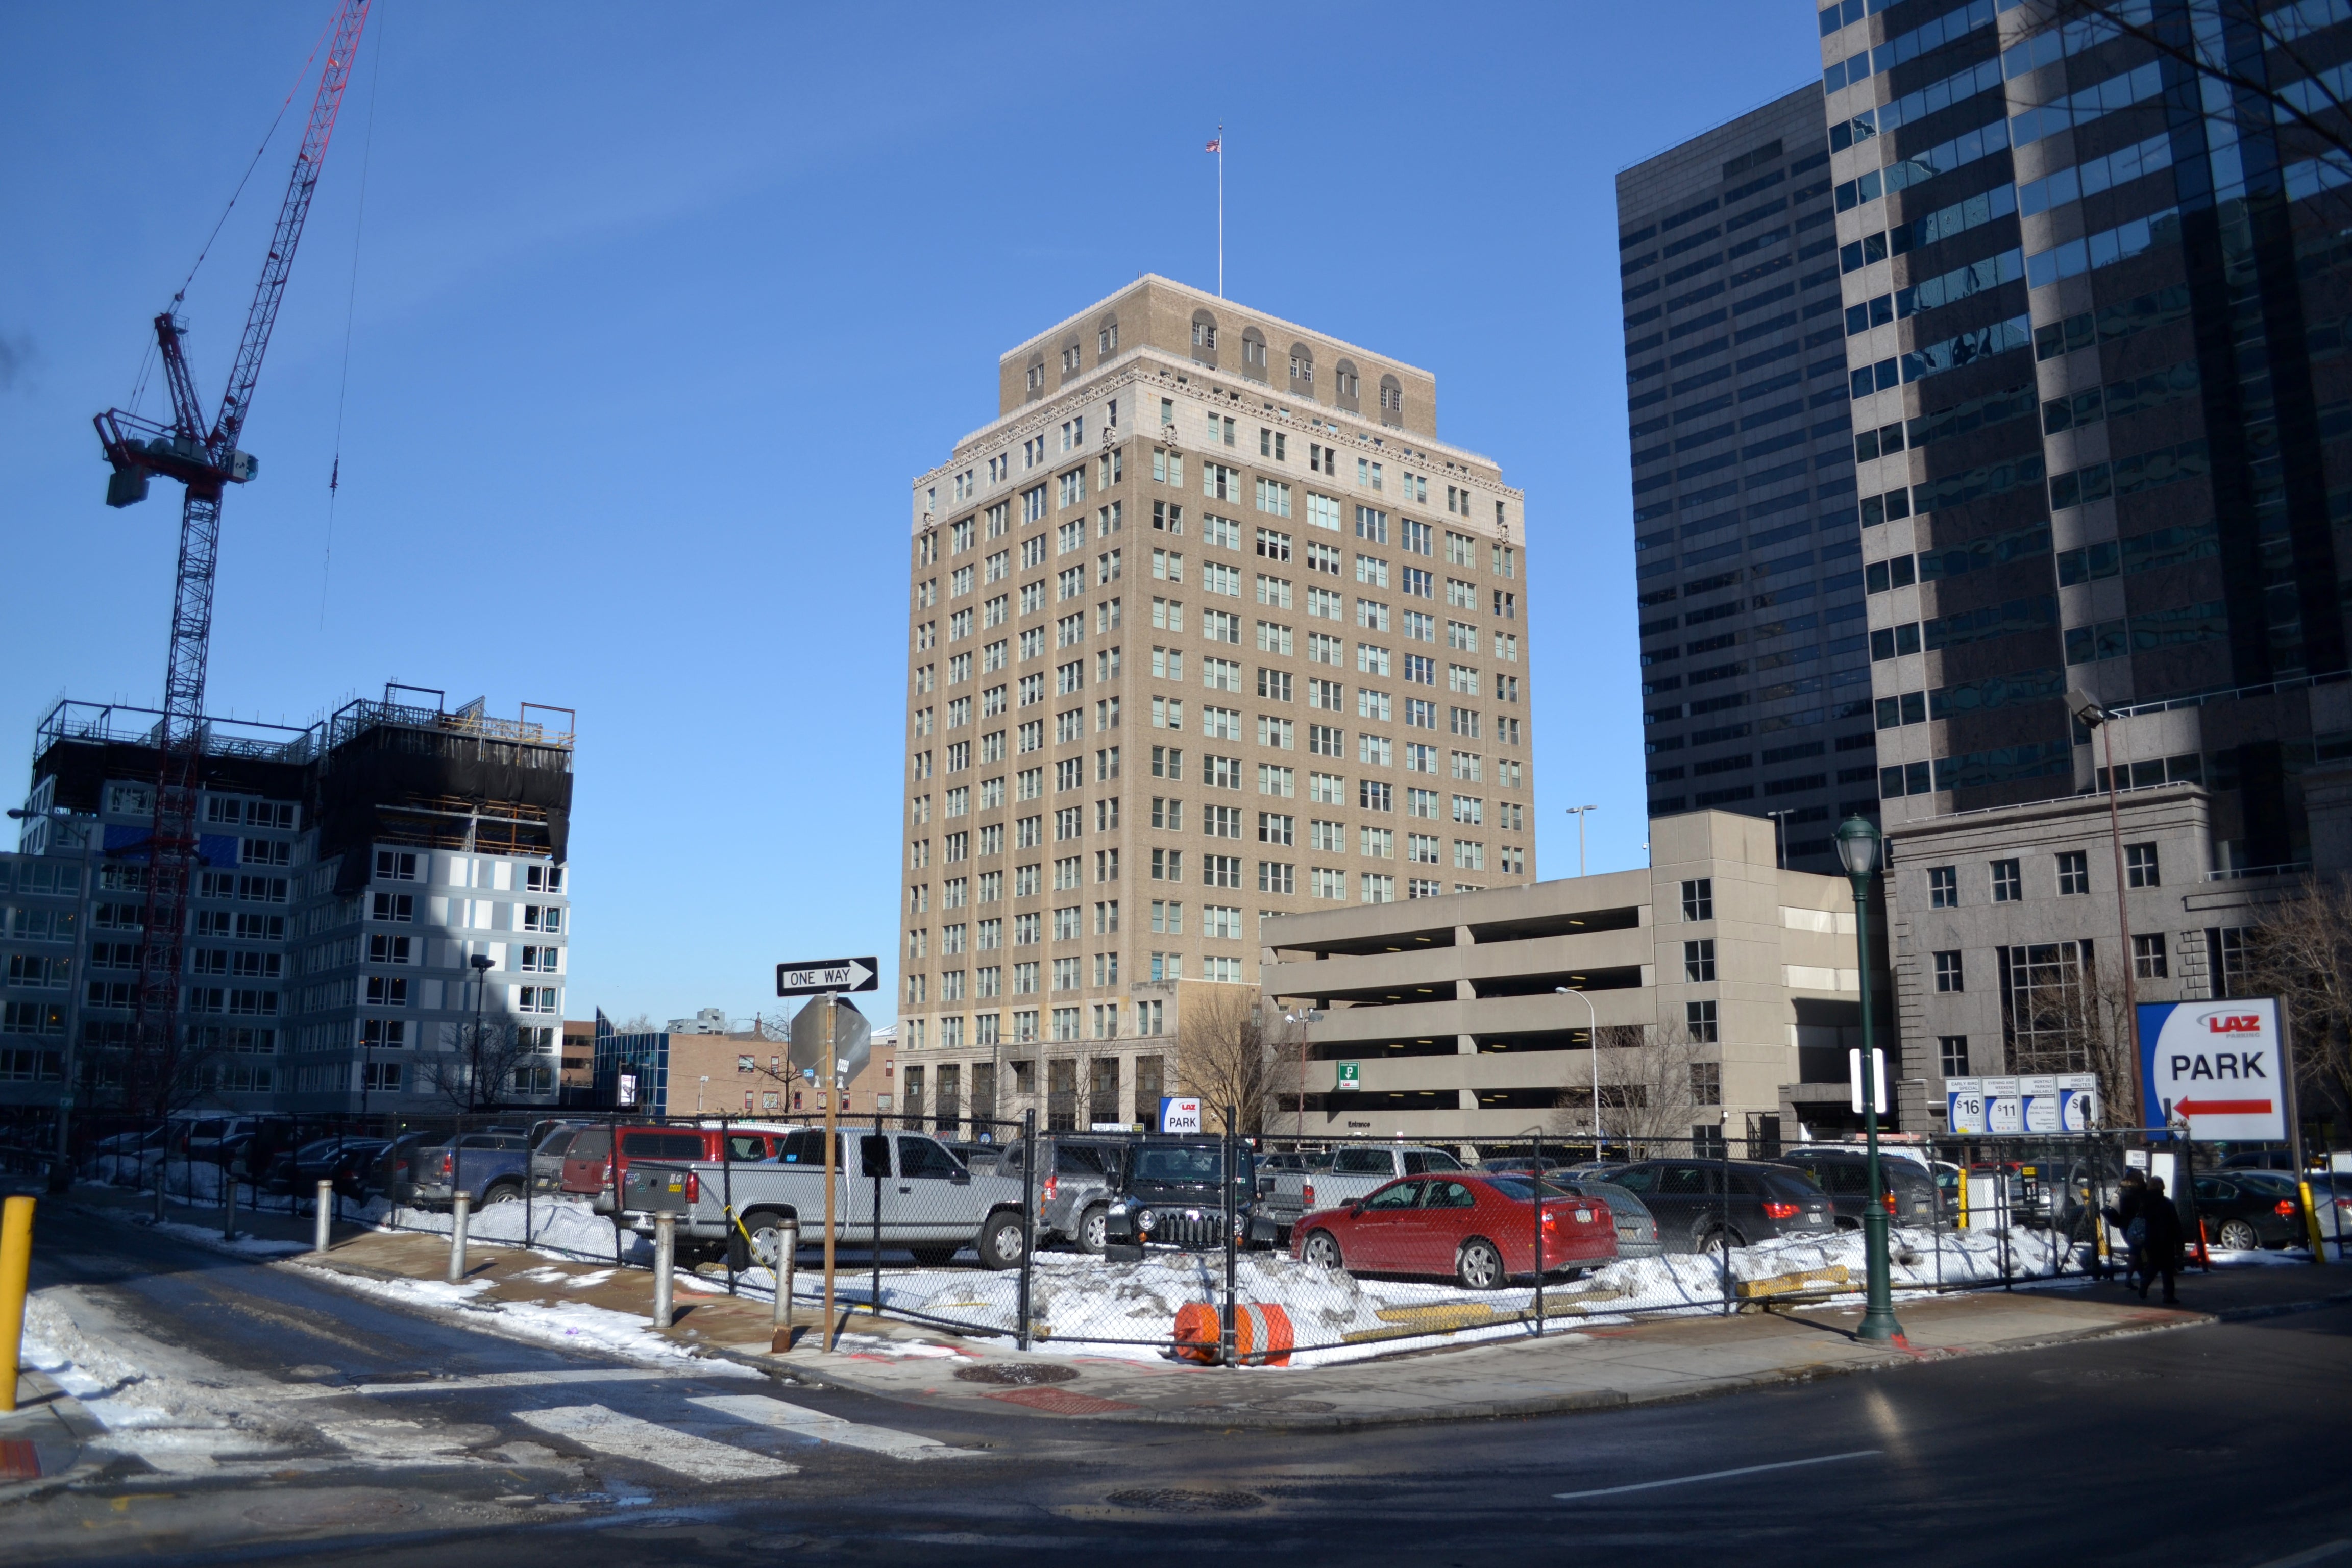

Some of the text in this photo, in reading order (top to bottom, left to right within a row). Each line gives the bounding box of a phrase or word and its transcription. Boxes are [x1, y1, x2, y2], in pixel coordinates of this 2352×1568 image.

[791, 968, 850, 986] ONE WAY
[2209, 1015, 2261, 1033] LAZ
[2171, 1051, 2267, 1081] PARK
[1957, 1099, 1980, 1114] $16
[1997, 1104, 2016, 1116] $11
[1169, 1117, 1196, 1127] PARK
